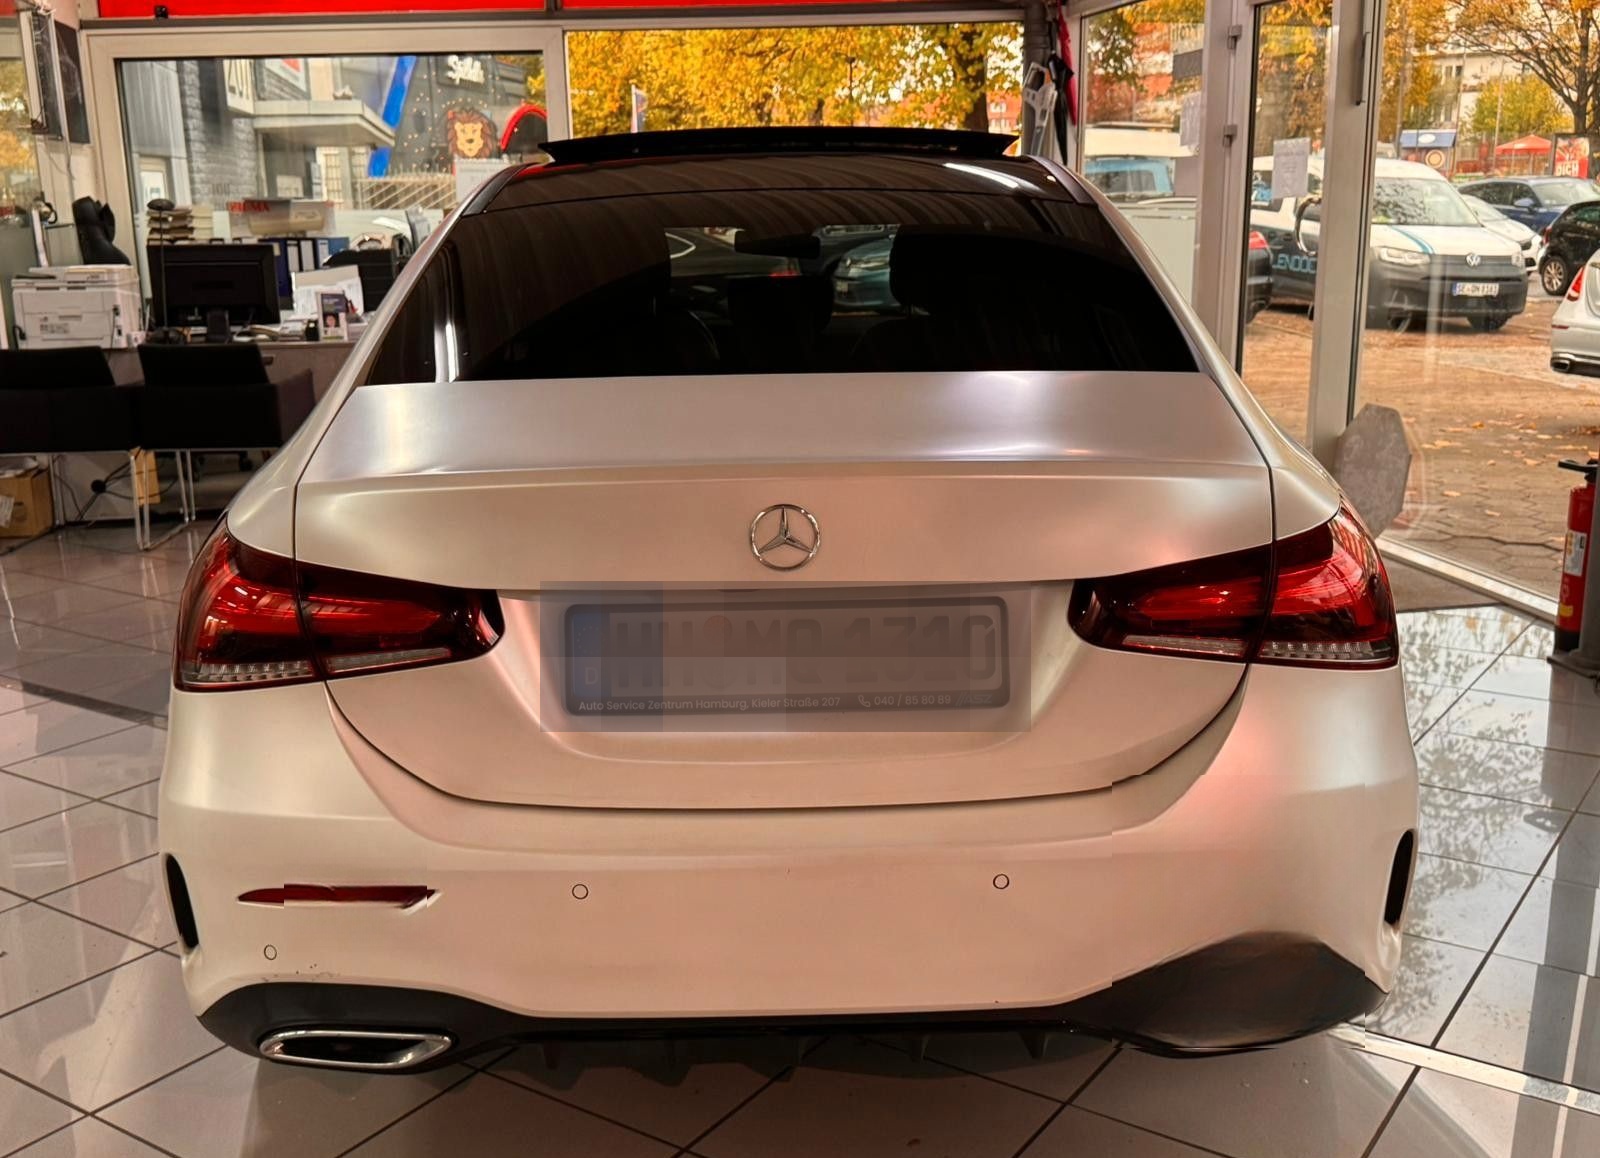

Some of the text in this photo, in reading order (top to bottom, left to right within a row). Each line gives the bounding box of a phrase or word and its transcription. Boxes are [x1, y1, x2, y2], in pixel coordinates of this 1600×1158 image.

[578, 697, 841, 712] Auto Service Zentrum Hamburg, Kieler Straße 207
[873, 695, 895, 706] 040
[905, 695, 919, 706] 85
[921, 695, 935, 706] 80
[937, 694, 951, 705] 89
